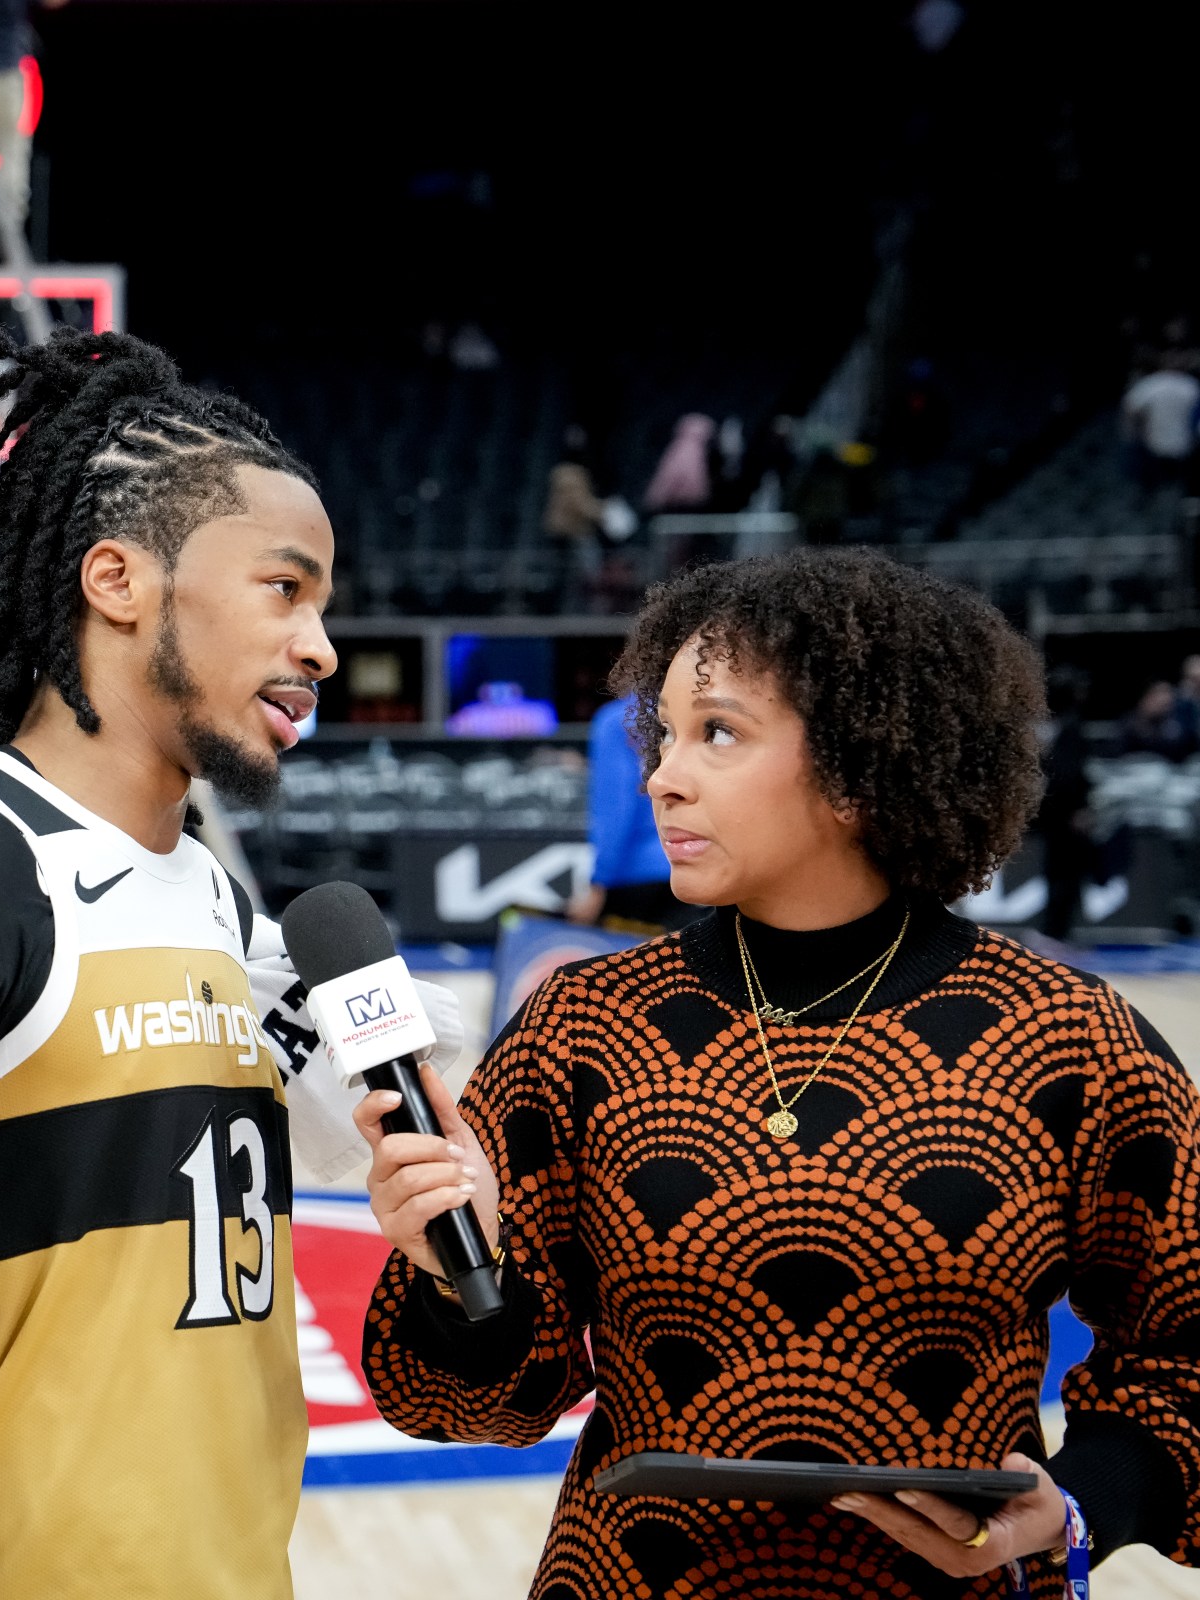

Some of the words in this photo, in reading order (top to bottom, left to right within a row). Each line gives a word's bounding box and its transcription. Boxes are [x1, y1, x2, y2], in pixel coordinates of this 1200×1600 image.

[342, 1012, 417, 1044] MONUMENTAL
[355, 1034, 379, 1046] SPORTS
[380, 1023, 409, 1036] NETWORK
[170, 1105, 274, 1329] 13
